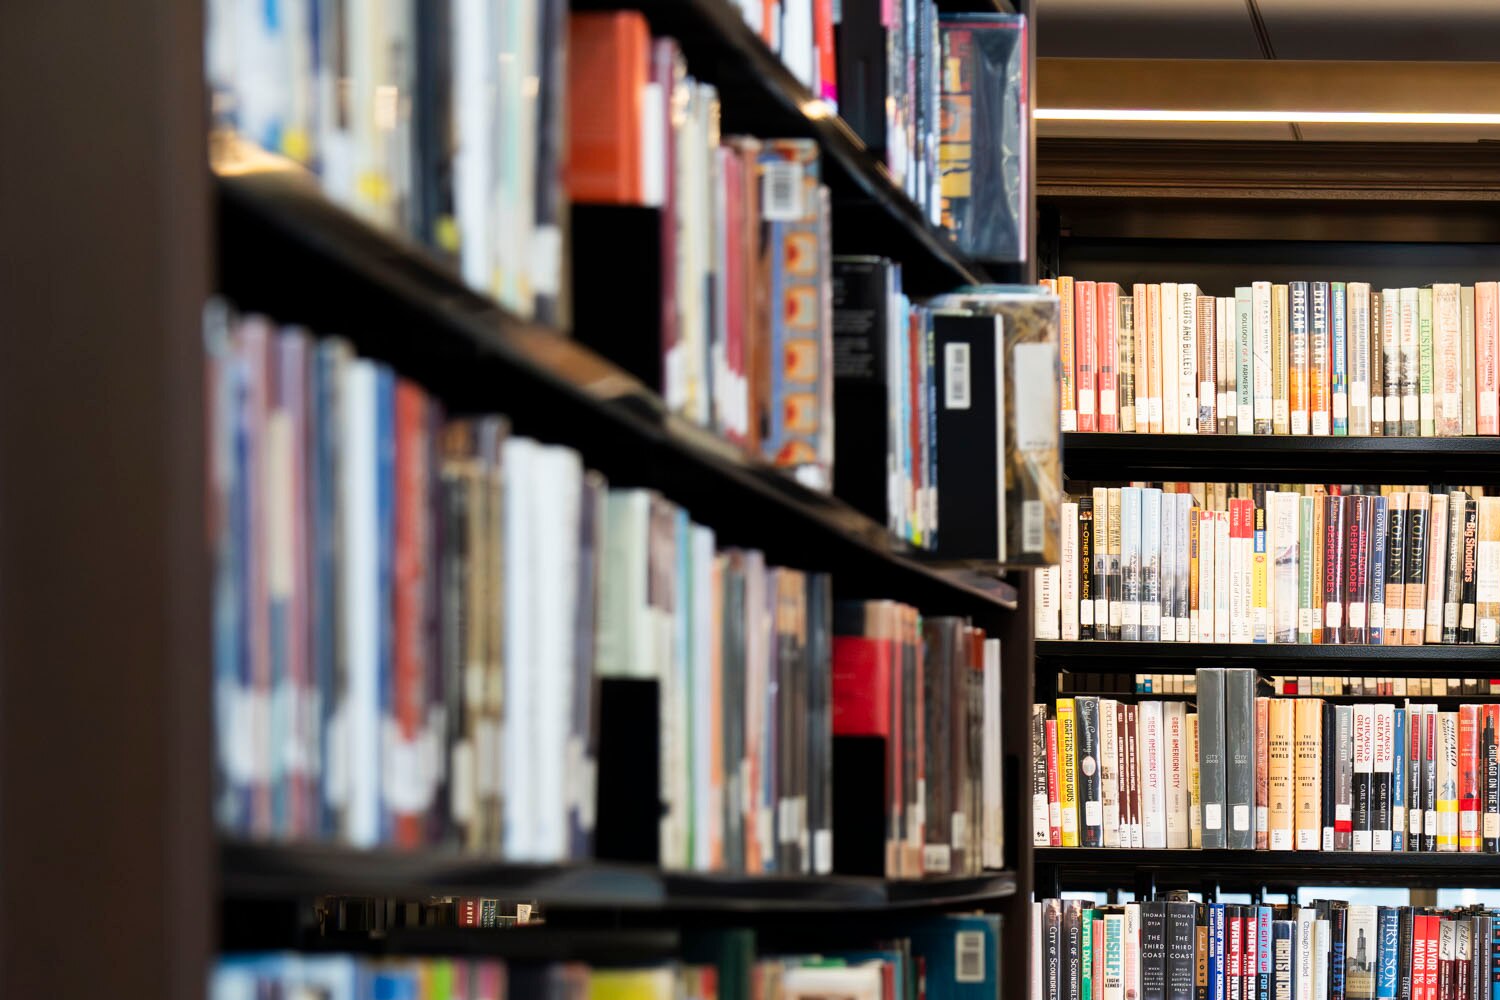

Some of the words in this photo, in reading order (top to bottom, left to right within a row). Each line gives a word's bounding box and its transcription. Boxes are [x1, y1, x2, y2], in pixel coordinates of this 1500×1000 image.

[1314, 289, 1325, 329] DREAM
[1314, 334, 1325, 364] TOWN
[1389, 514, 1401, 578] GOLDEN
[1409, 514, 1422, 578] GOLDEN
[1464, 538, 1475, 582] Shoulders
[1488, 745, 1497, 776] CHICAGO
[1489, 779, 1497, 788] ON
[1489, 790, 1497, 804] THE
[1070, 927, 1078, 944] CITY
[1082, 919, 1090, 944] AFTER
[1247, 921, 1255, 952] WHEN
[1301, 921, 1310, 949] Chicago
[1385, 915, 1398, 953] FIRST
[1070, 948, 1077, 956] OF
[1082, 946, 1090, 979] DALEY
[1105, 919, 1121, 976] HIMSELF!
[1414, 939, 1424, 970] MAYOR
[1427, 939, 1438, 970] MAYOR
[1261, 961, 1268, 971] UP
[1302, 952, 1310, 977] Divided
[1384, 958, 1397, 988] SON
[1414, 973, 1424, 984] 1%
[1426, 973, 1437, 984] 1%
